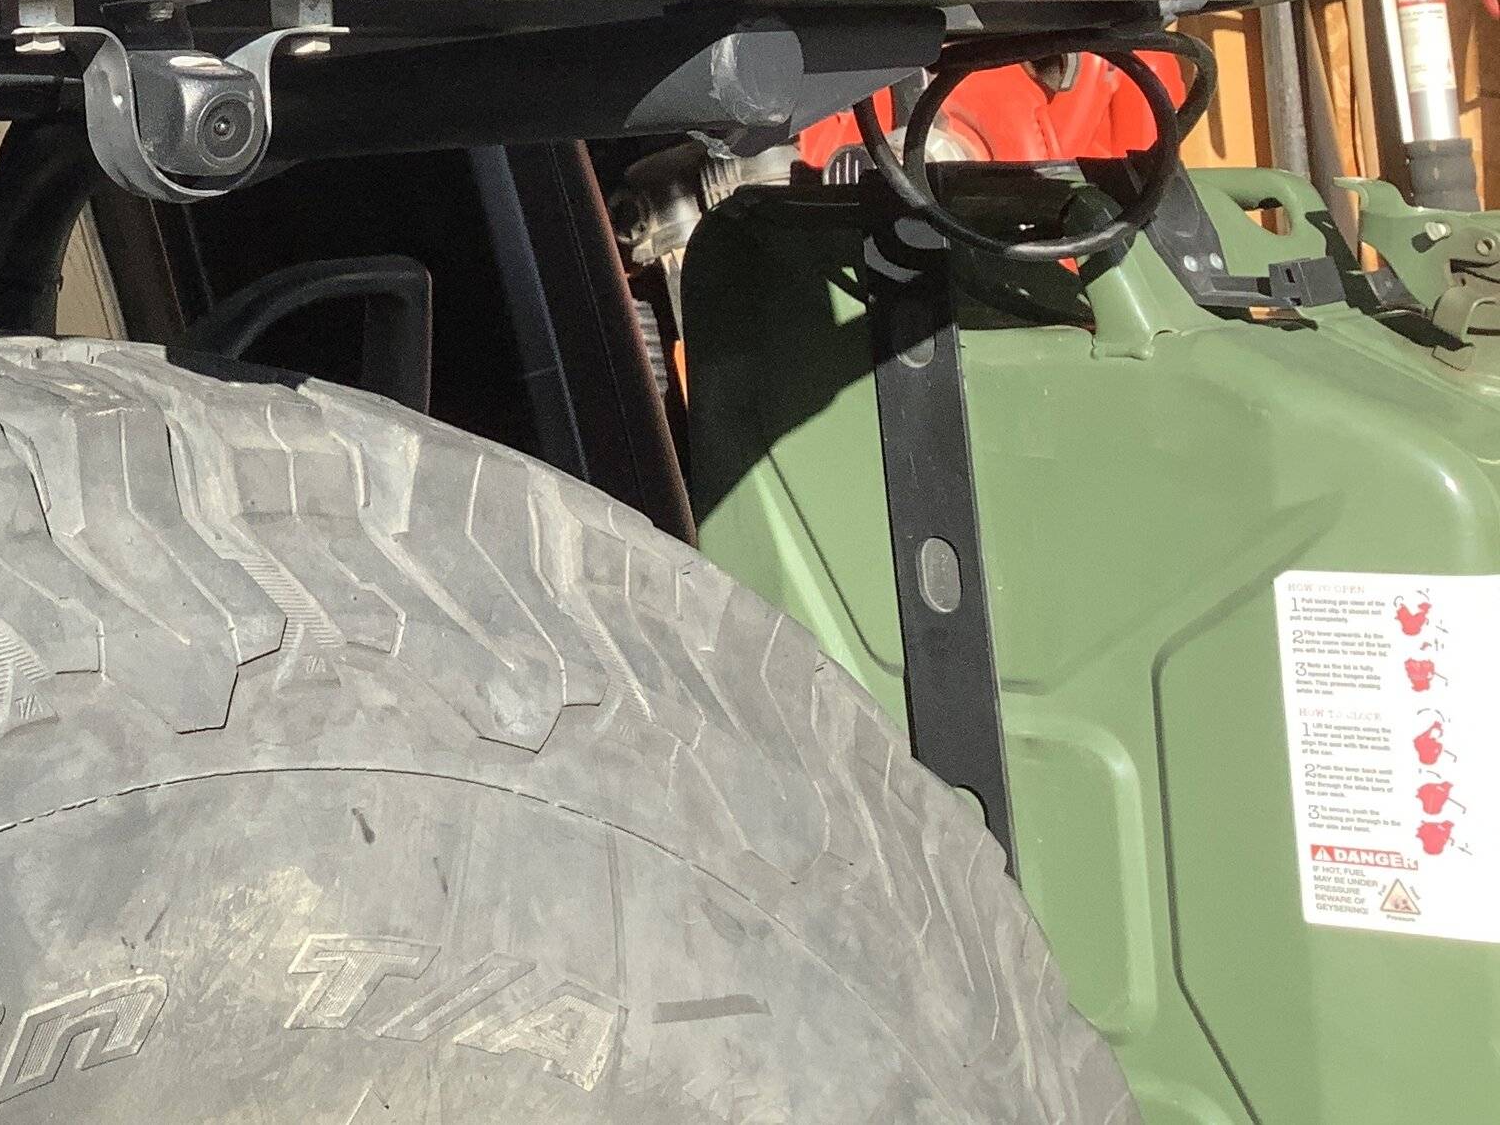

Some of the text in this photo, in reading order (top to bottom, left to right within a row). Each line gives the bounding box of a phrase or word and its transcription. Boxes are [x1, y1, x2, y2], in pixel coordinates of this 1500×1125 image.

[1288, 583, 1313, 591] HOW
[1334, 585, 1364, 593] OPEN
[1292, 597, 1300, 611] 1
[1292, 630, 1304, 644] 2
[1295, 662, 1307, 676] 3
[1300, 708, 1324, 717] HOW
[1302, 722, 1311, 736] 1
[1304, 764, 1317, 778] 2
[1308, 805, 1319, 819] 3
[1334, 848, 1418, 869] DANGER
[1344, 869, 1365, 877] FUEL
[1347, 878, 1378, 887] UNDER
[1315, 885, 1360, 895] PRESSURE
[1315, 894, 1352, 903] BEWARE
